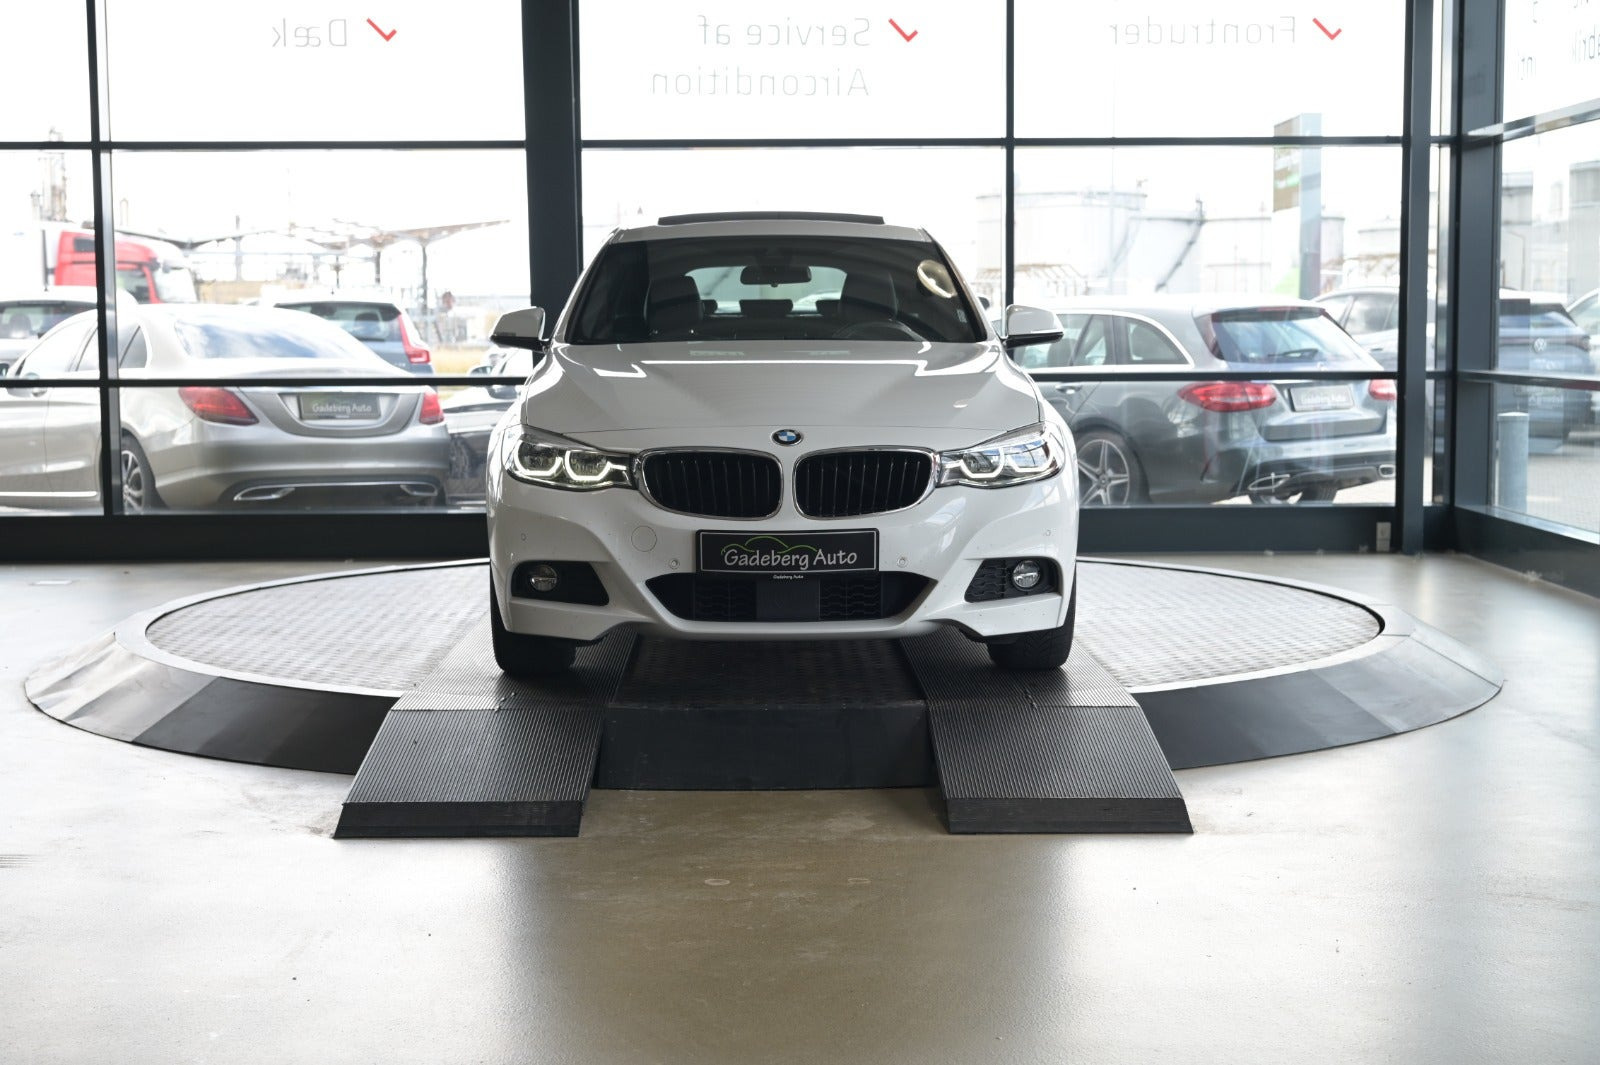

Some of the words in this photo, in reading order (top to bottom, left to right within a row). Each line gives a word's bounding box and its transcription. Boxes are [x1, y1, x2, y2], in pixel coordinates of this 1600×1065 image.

[351, 403, 372, 412] Auto
[723, 549, 809, 570] Gadeberg
[813, 549, 858, 565] Auto
